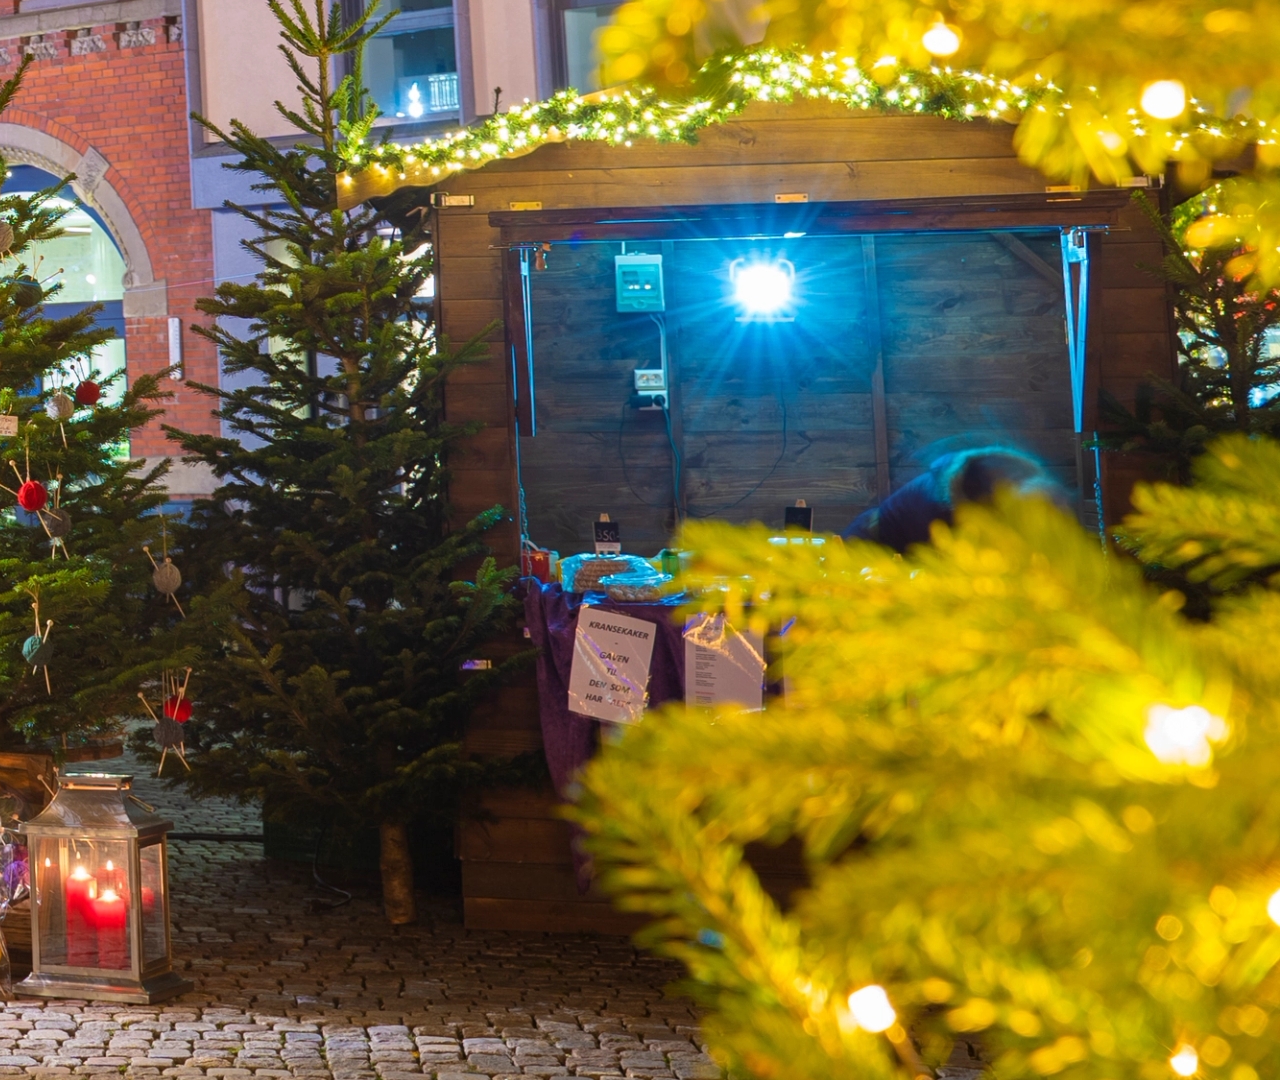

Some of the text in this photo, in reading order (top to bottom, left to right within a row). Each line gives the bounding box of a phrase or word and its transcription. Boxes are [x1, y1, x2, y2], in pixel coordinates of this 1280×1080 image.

[589, 621, 650, 640] KRANSEKAKER
[600, 651, 630, 664] GAVEN
[589, 679, 608, 689] DEN
[610, 683, 631, 694] SOM
[585, 693, 603, 703] HAR
